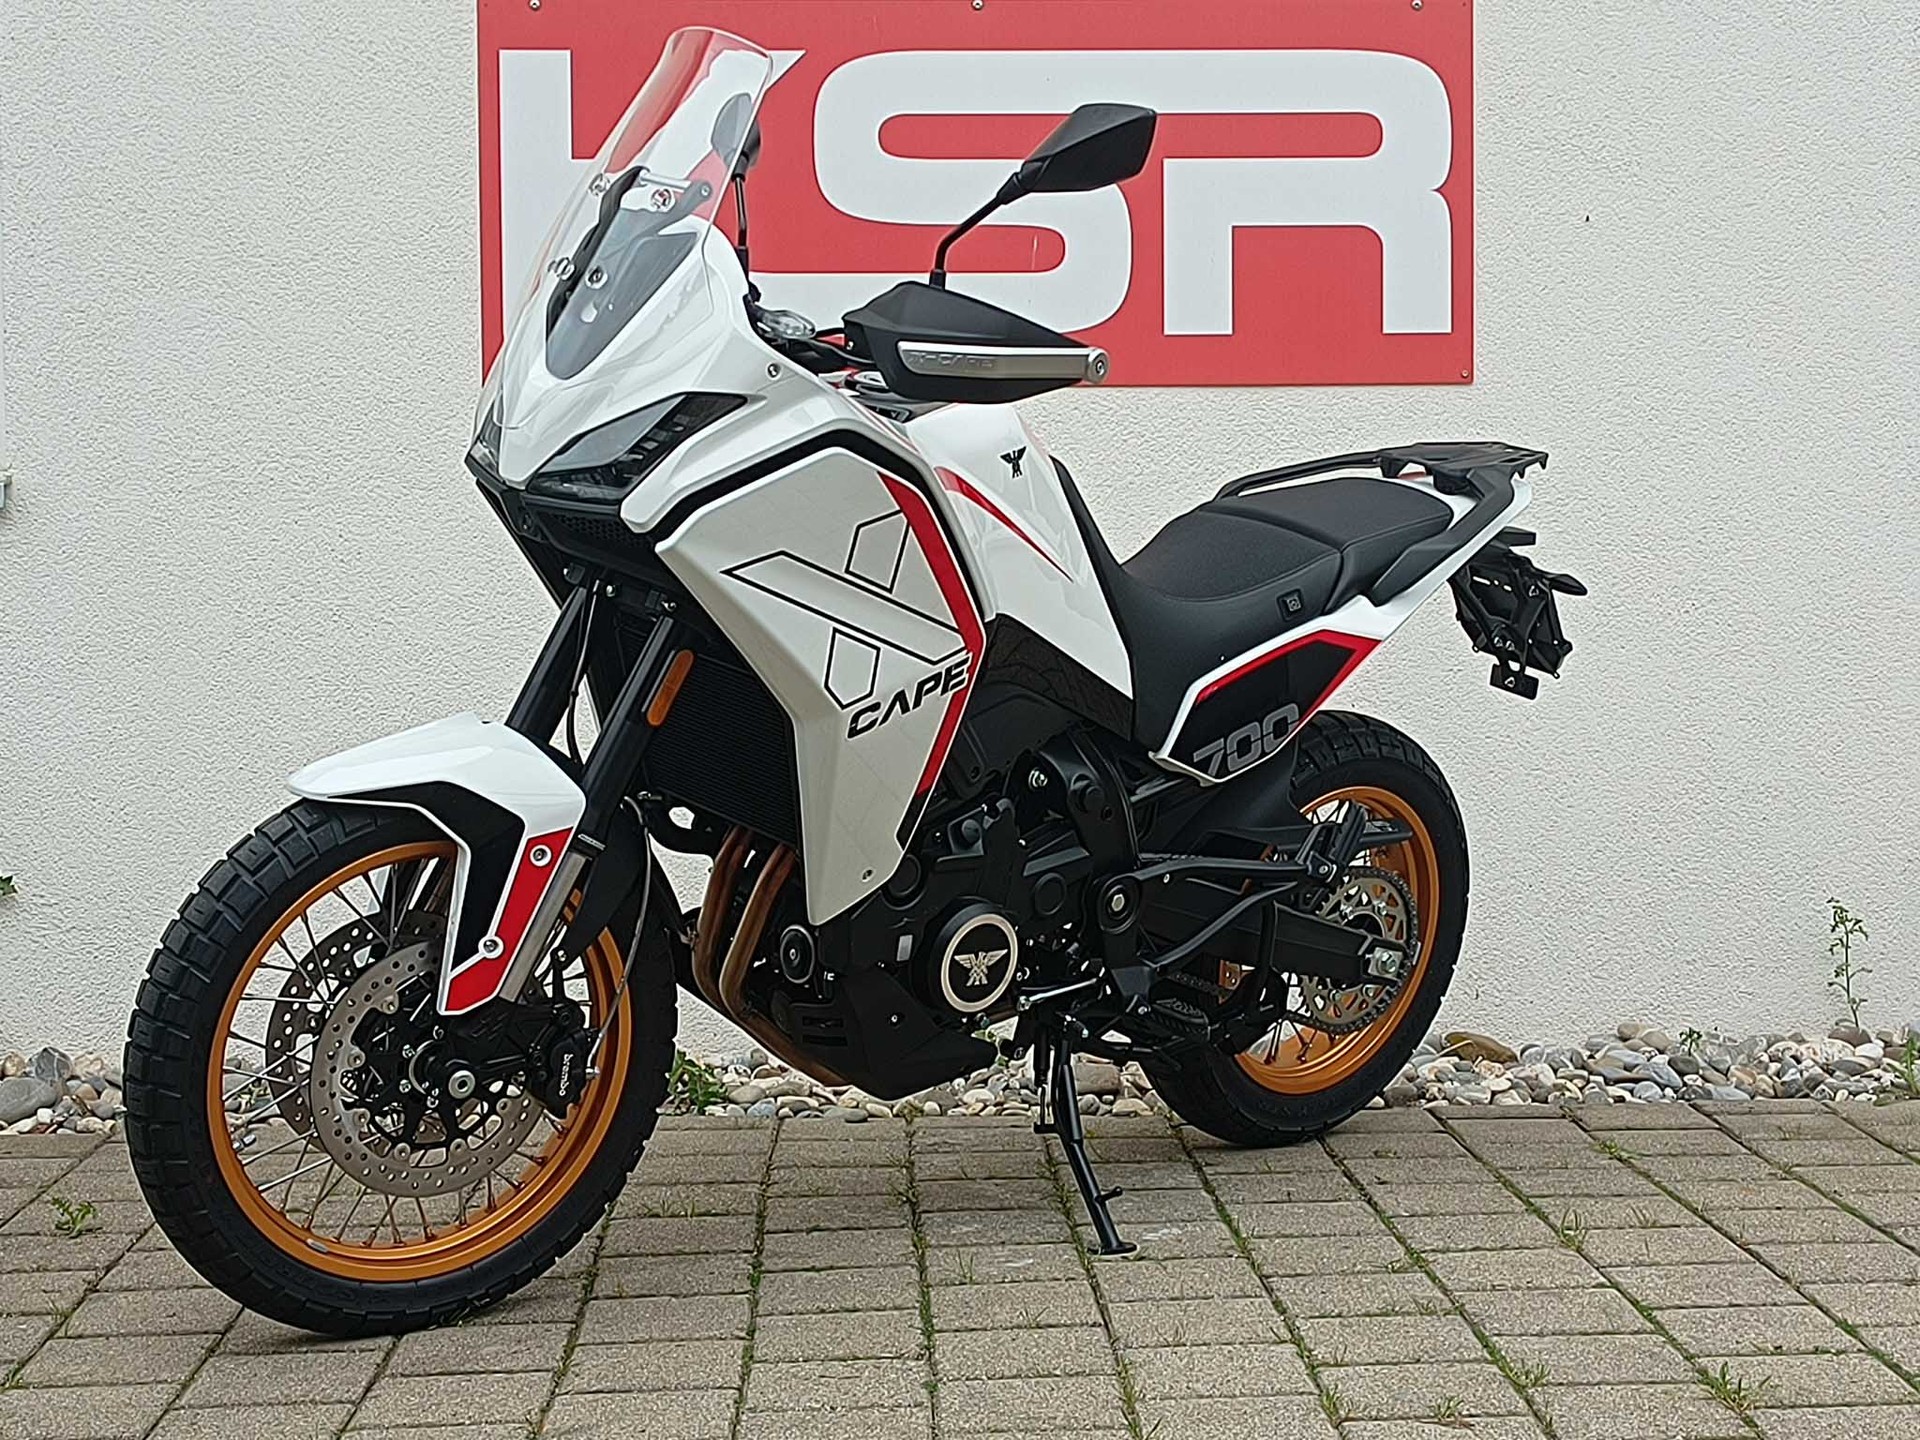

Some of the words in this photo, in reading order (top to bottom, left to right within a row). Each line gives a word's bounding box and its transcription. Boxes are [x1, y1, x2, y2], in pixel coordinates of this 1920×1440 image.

[498, 48, 1454, 336] KSR
[847, 655, 971, 739] CAPE
[1193, 703, 1300, 777] 700
[559, 1053, 574, 1096] brembo
